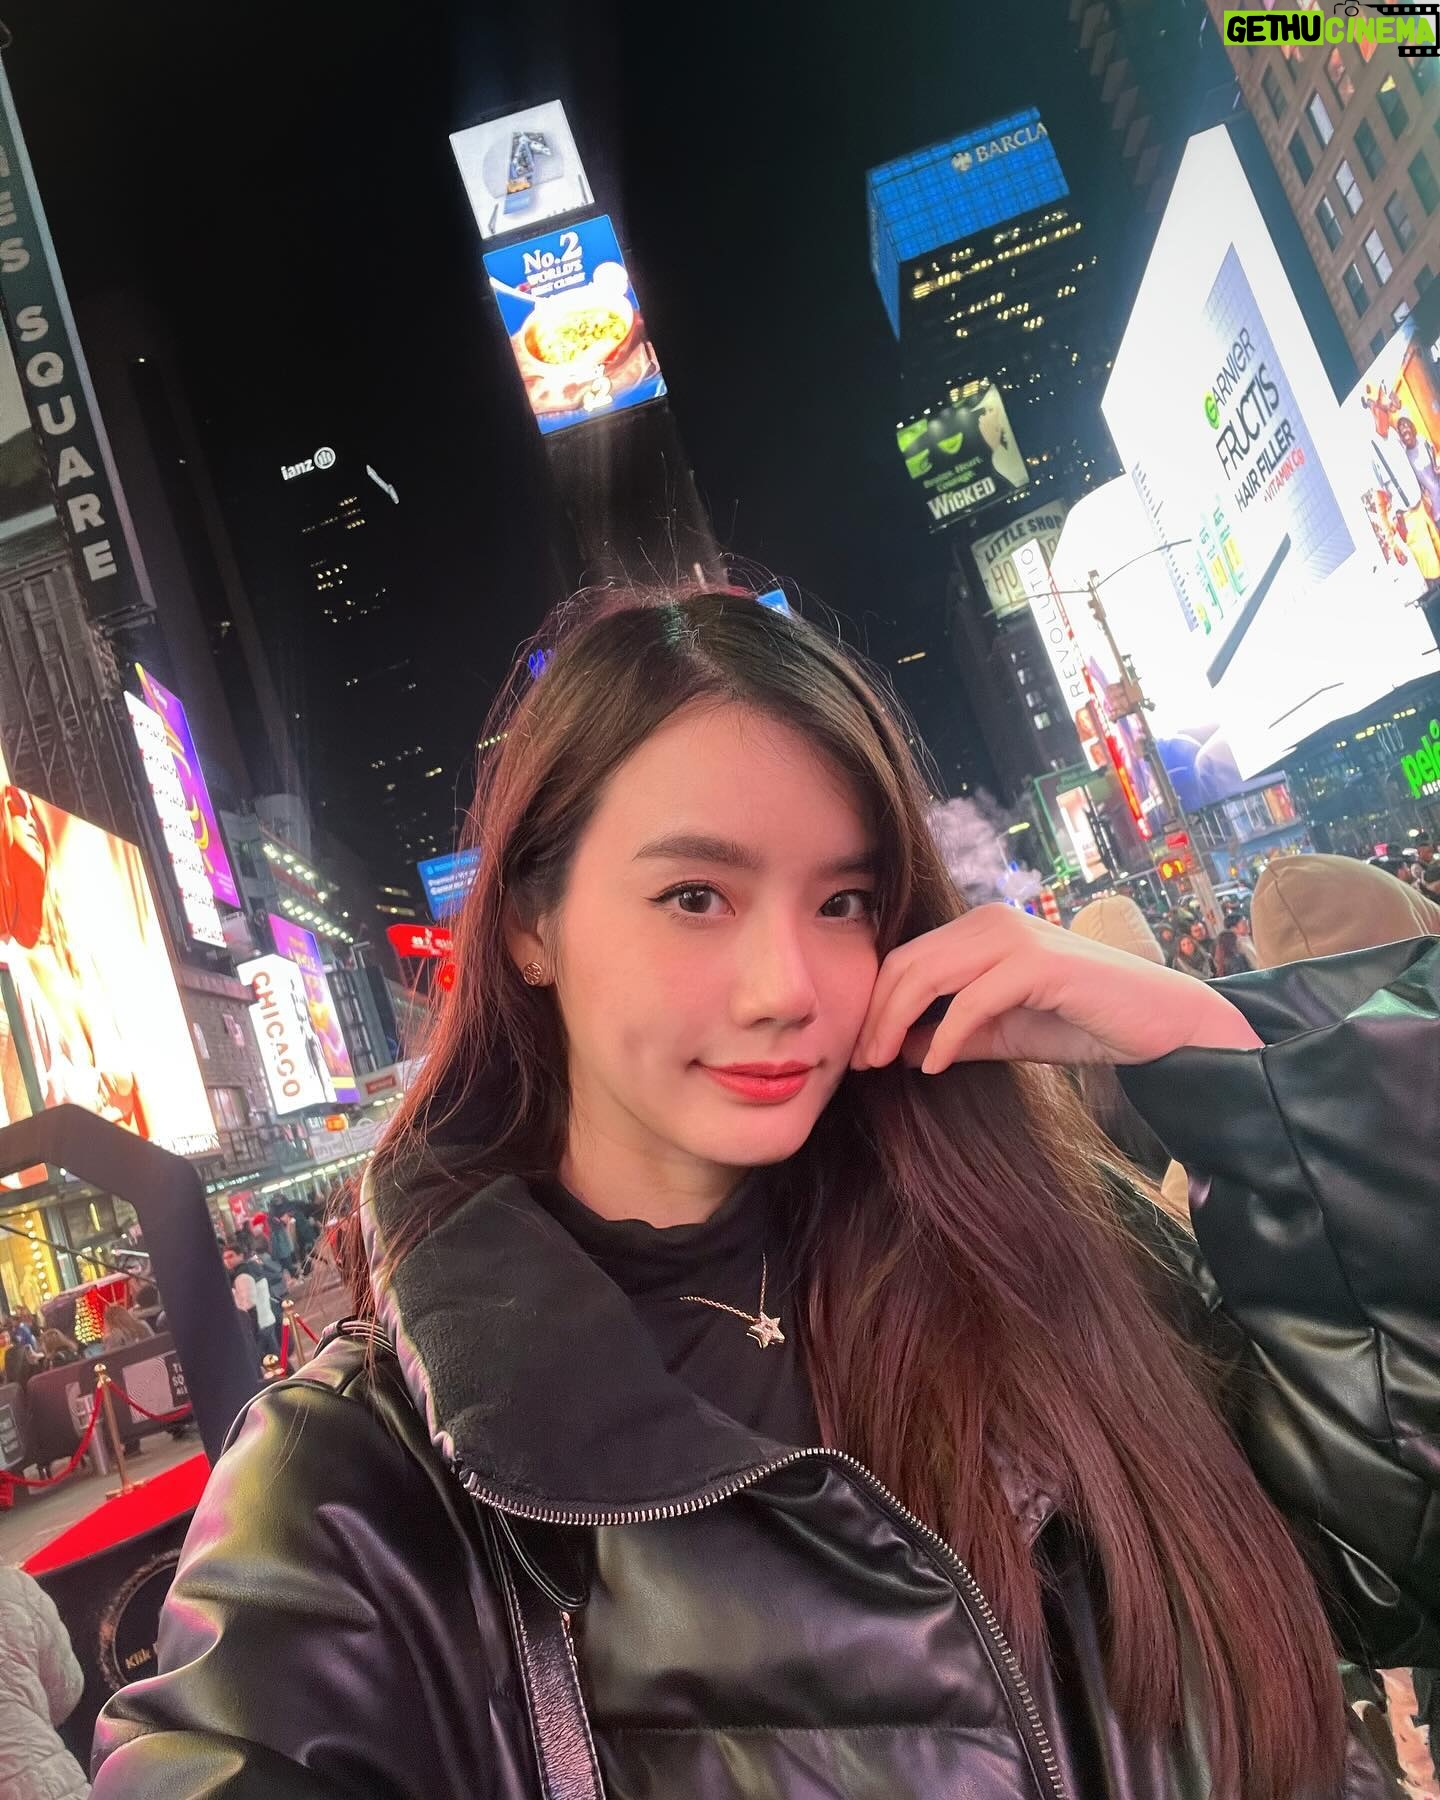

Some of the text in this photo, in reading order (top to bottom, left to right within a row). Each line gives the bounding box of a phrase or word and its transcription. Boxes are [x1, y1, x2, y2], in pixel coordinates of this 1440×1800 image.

[976, 122, 1049, 162] BARCLA
[522, 231, 583, 274] No.2
[1204, 327, 1256, 426] GARNIER
[1215, 361, 1280, 480] FRUCTIS
[16, 305, 117, 581] SQUARE
[1234, 418, 1296, 512] HAIR FILLER
[926, 477, 997, 520] WICKED
[985, 523, 1027, 564] LITTLE
[252, 971, 300, 1097] CHICAGO
